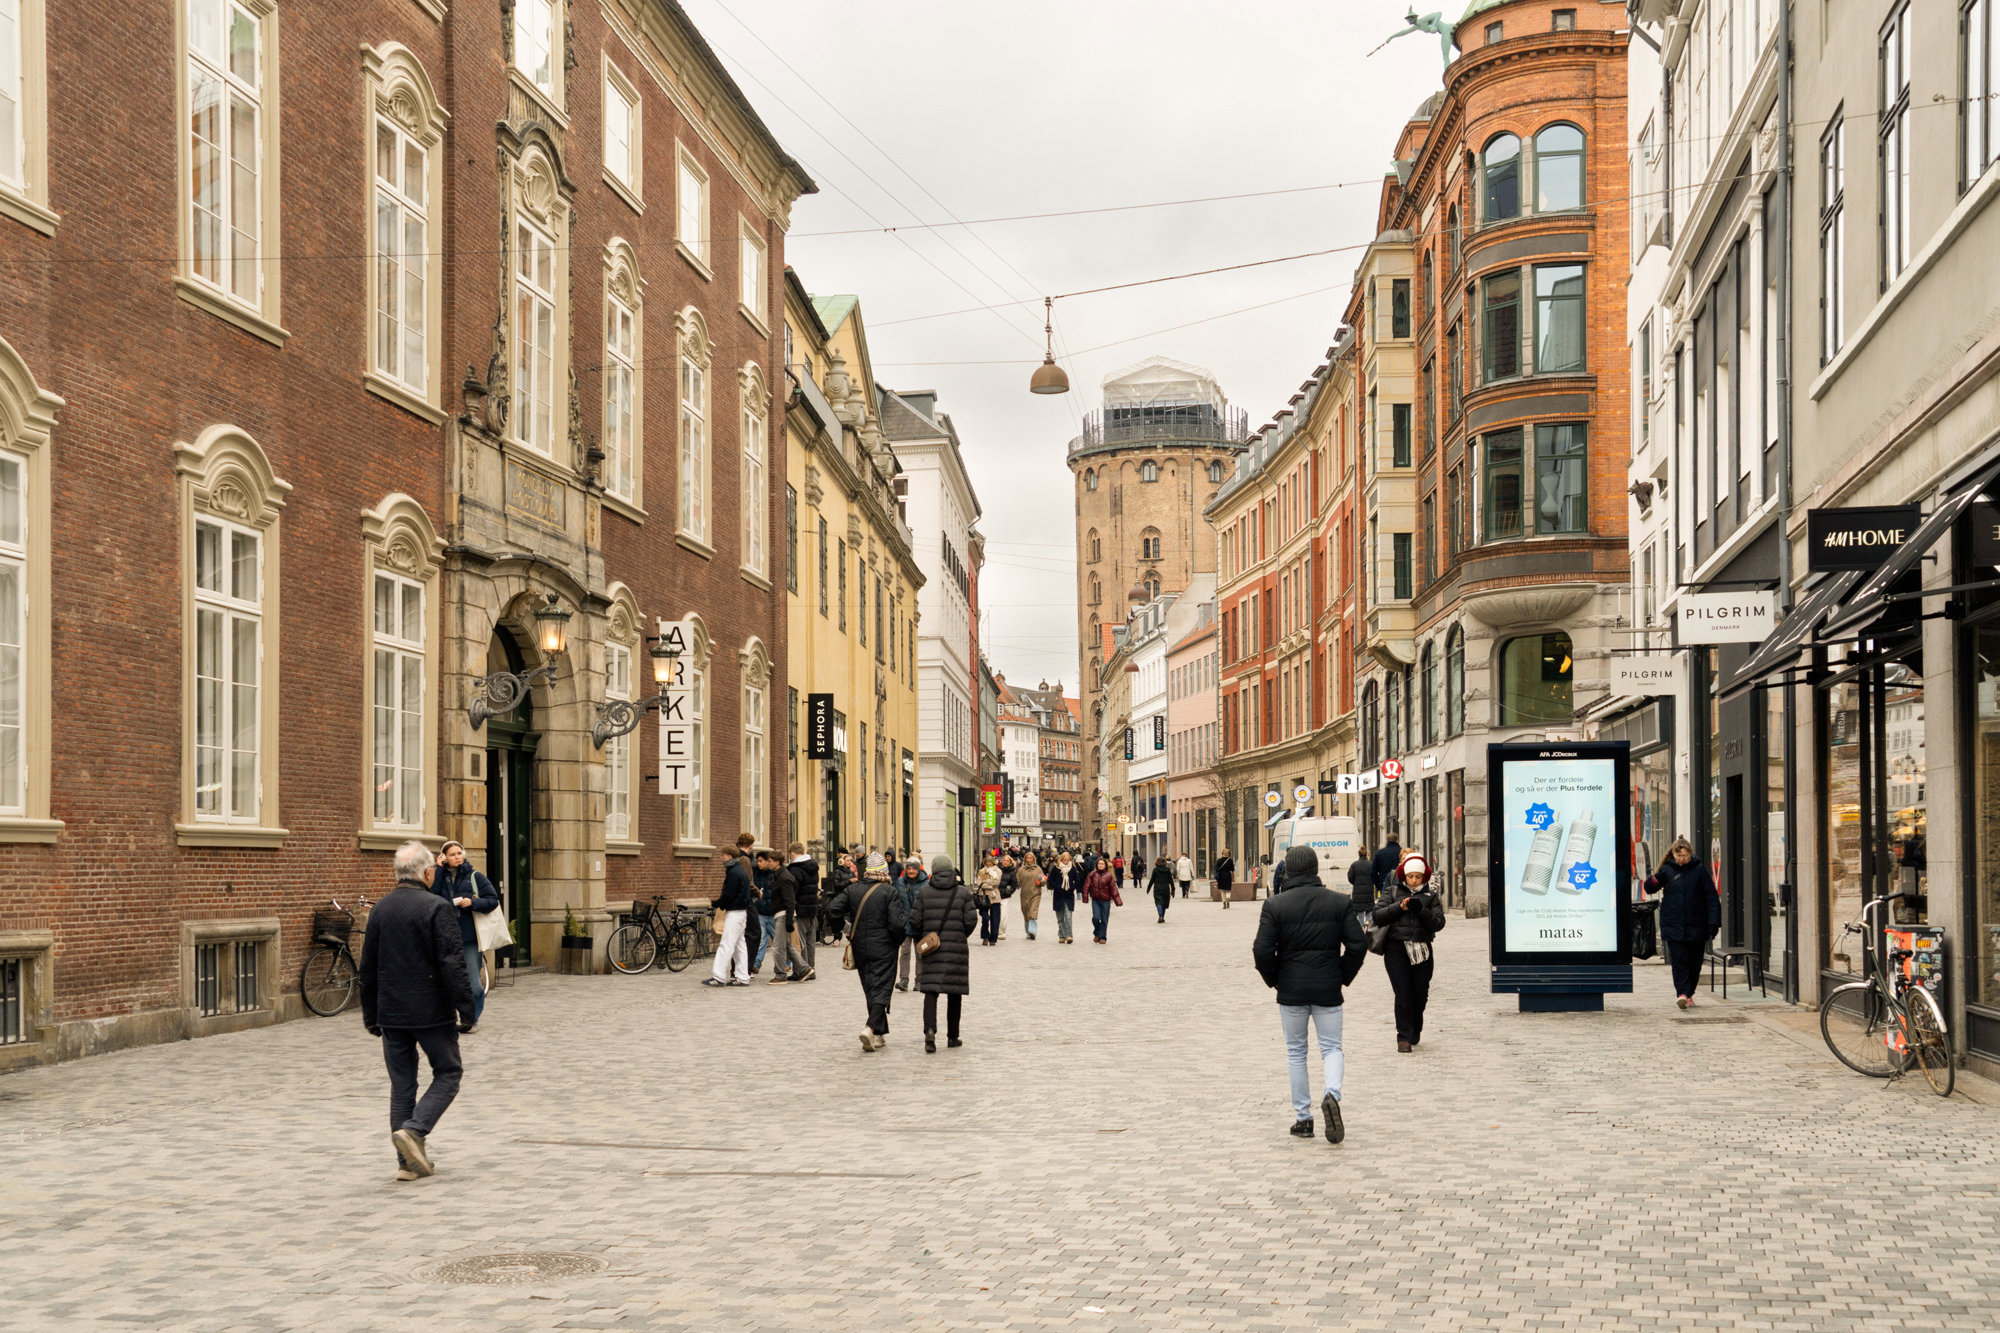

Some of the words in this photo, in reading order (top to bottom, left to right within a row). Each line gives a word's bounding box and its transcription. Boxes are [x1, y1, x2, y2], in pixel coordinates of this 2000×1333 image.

[1824, 531, 1848, 548] H&M
[1848, 529, 1905, 546] HOME
[1686, 606, 1765, 619] PILGRIM
[1621, 670, 1673, 678] PILGRIM
[817, 700, 825, 752] SEPHORA
[1539, 928, 1583, 938] matas
